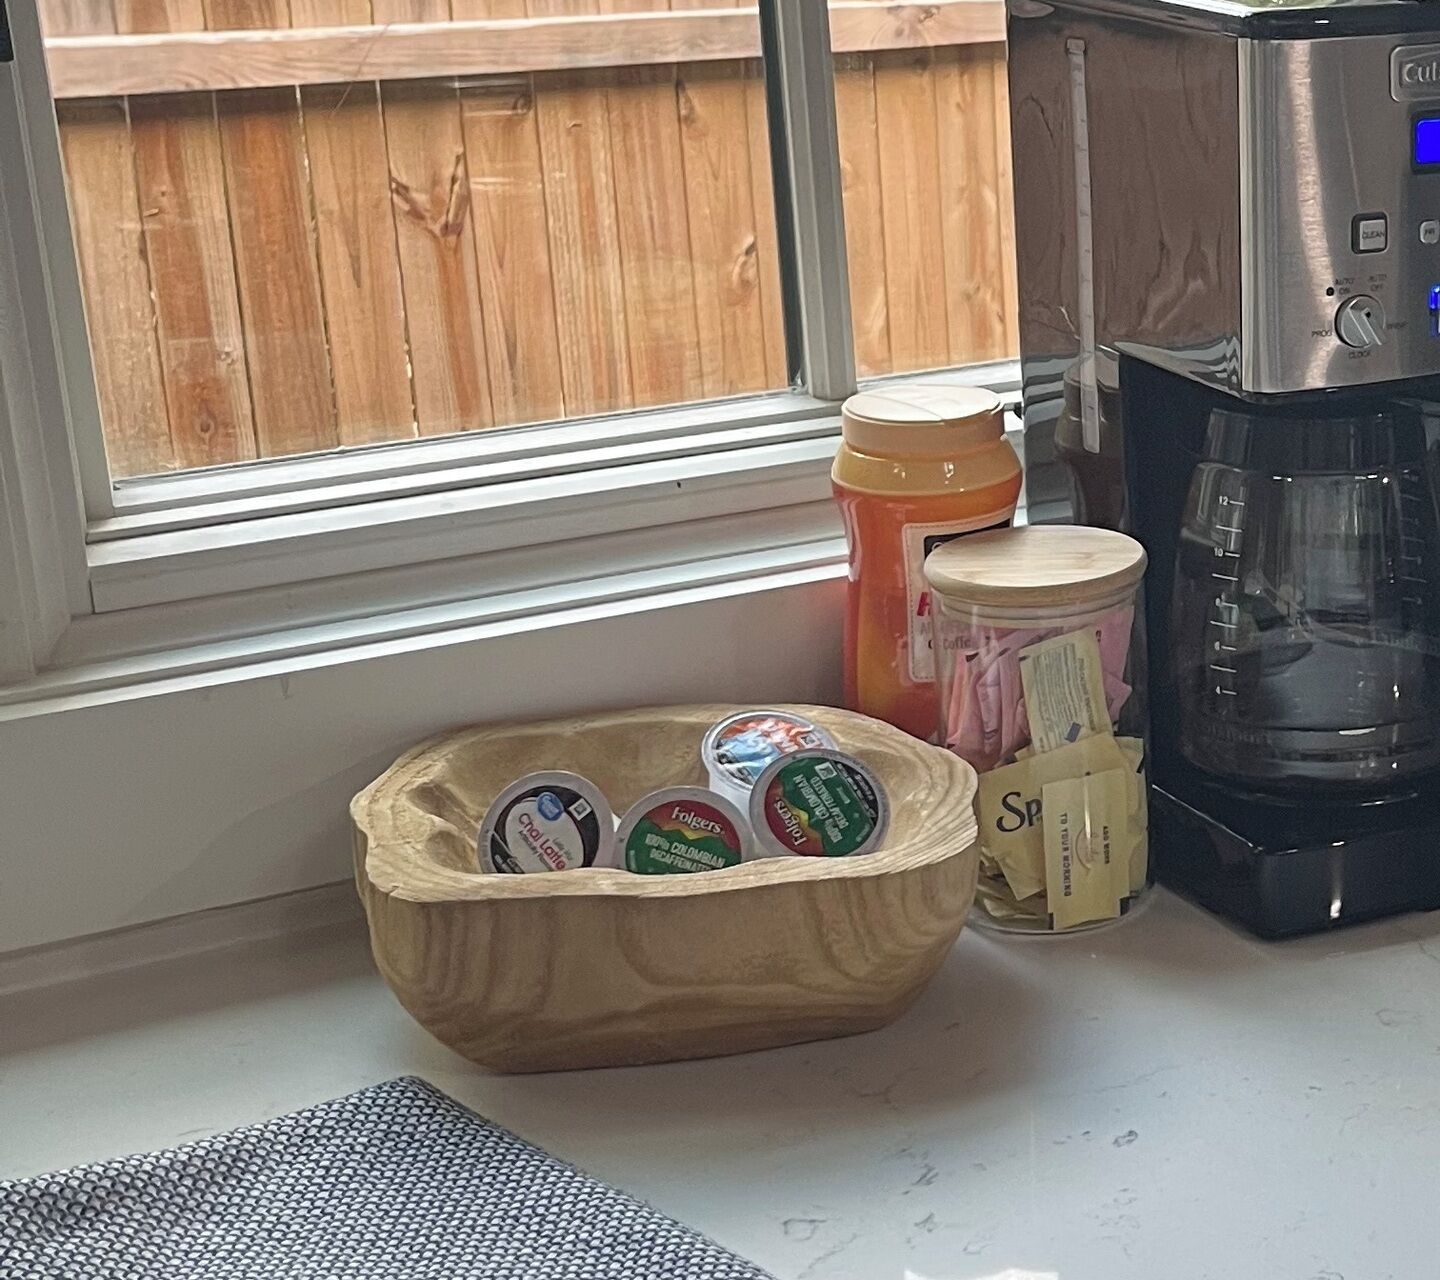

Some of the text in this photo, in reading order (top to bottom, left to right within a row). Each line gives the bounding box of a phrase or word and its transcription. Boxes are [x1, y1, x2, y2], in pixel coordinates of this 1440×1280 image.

[1362, 231, 1385, 240] CLEAN
[1218, 495, 1229, 506] 12
[1214, 546, 1224, 557] 10
[793, 773, 829, 821] COLOMBIAN
[810, 776, 849, 829] DECAFFEINATED
[996, 791, 1043, 833] Sp
[671, 807, 723, 834] Folgers
[773, 799, 807, 845] Folgers
[540, 838, 566, 871] Latte
[671, 842, 726, 868] COLOMBIAN
[1061, 827, 1070, 853] YOUR
[1062, 855, 1072, 897] MORNING
